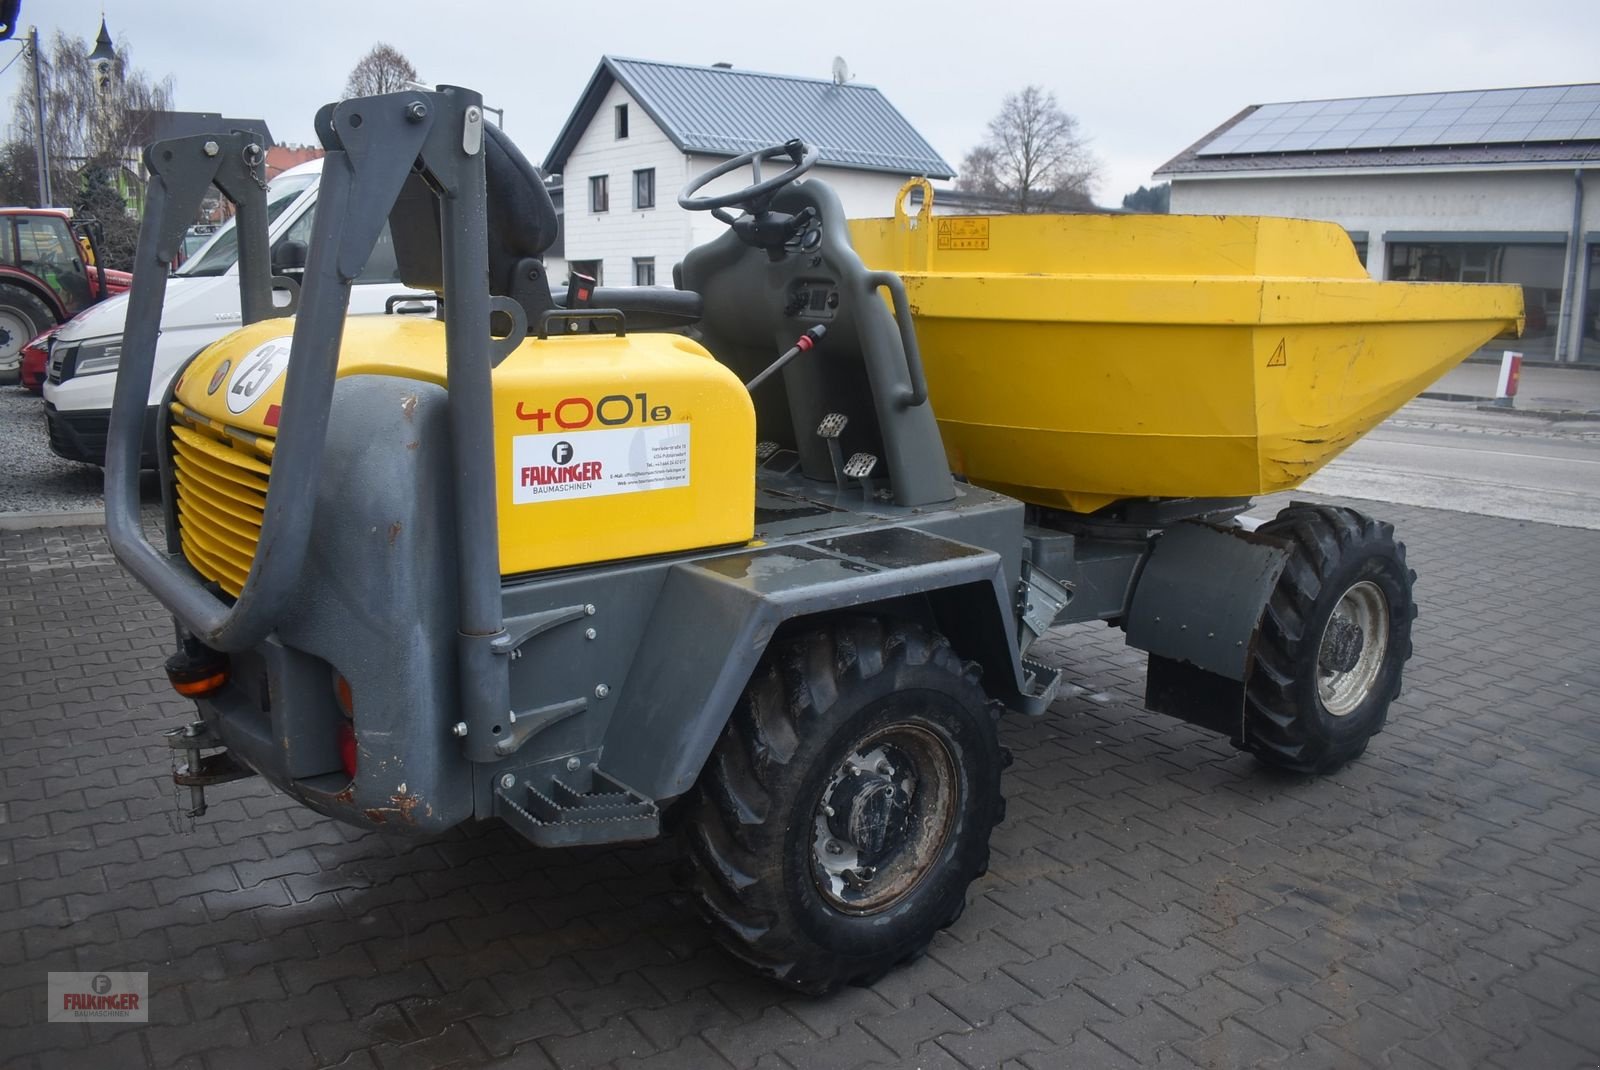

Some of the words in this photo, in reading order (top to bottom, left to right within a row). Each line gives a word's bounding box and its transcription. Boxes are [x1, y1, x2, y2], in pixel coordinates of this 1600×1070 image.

[231, 344, 289, 397] 25
[521, 461, 603, 487] FALKINGER
[533, 482, 593, 494] BAUMASCHINEN
